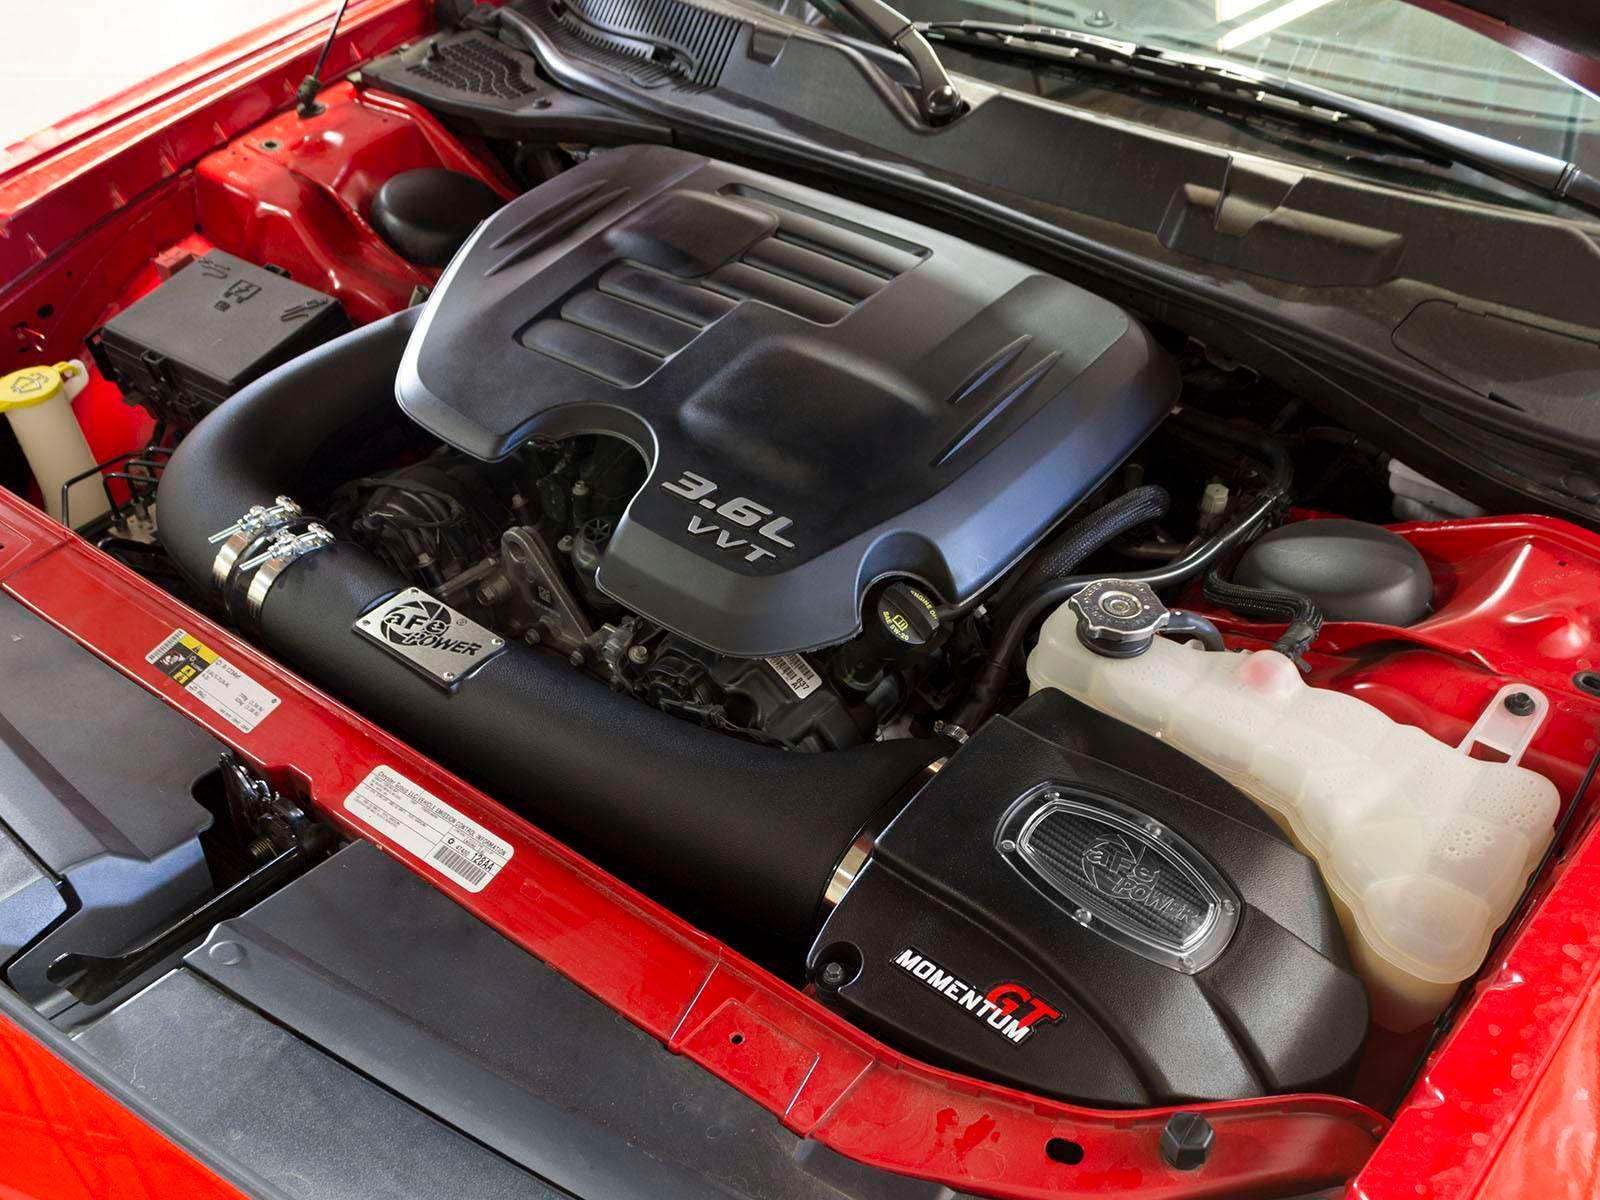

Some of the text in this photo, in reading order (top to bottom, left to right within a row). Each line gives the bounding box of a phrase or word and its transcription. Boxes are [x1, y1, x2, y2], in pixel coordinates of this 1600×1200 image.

[661, 470, 796, 549] 3.6L
[687, 515, 777, 562] VVT
[402, 631, 482, 656] POWER
[416, 795, 437, 811] VEHICLE
[454, 820, 477, 837] CONTROL
[473, 832, 508, 857] INFORMATION
[469, 851, 496, 873] 128AA
[1111, 877, 1200, 922] POWER
[895, 949, 1031, 1043] MOMENTUM
[986, 983, 1062, 1029] GT
